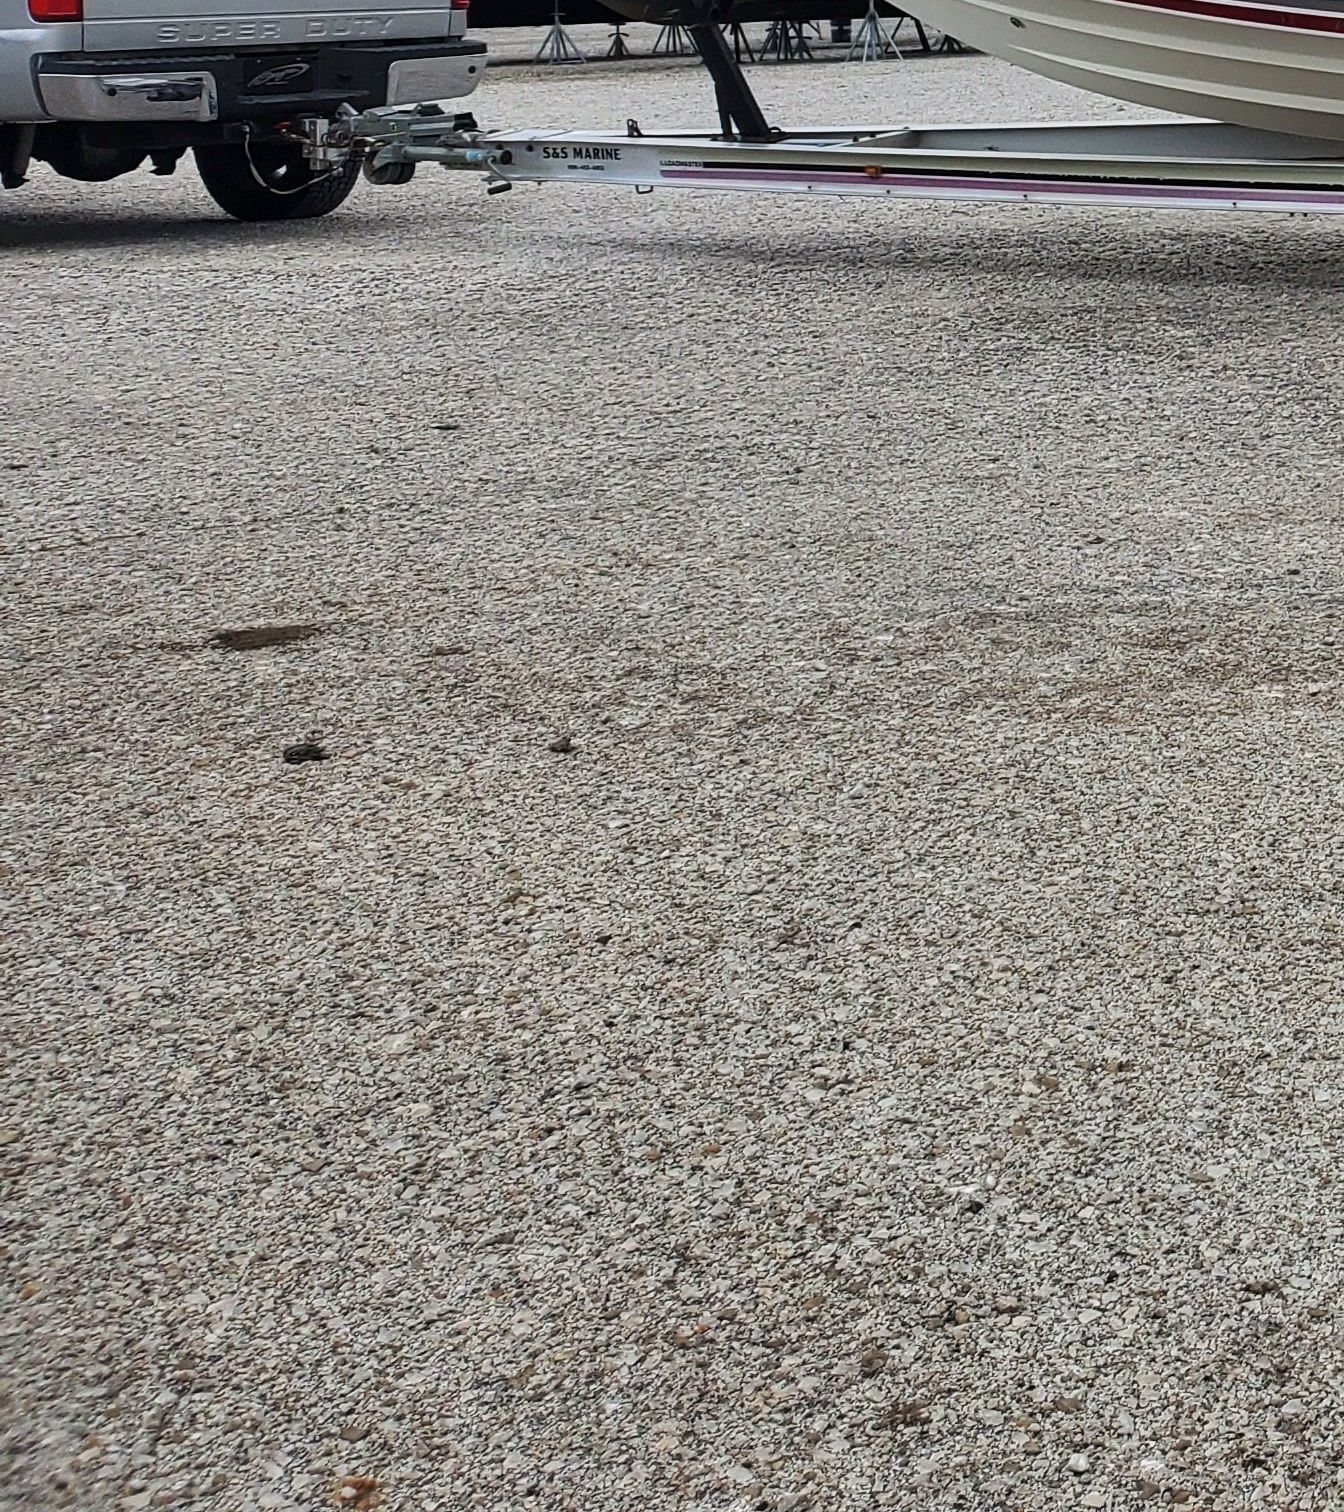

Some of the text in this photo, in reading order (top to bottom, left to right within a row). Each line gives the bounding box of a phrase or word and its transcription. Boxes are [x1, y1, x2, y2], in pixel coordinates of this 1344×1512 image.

[157, 16, 394, 44] SUPER DUTY
[542, 146, 623, 161] S&S MARINE
